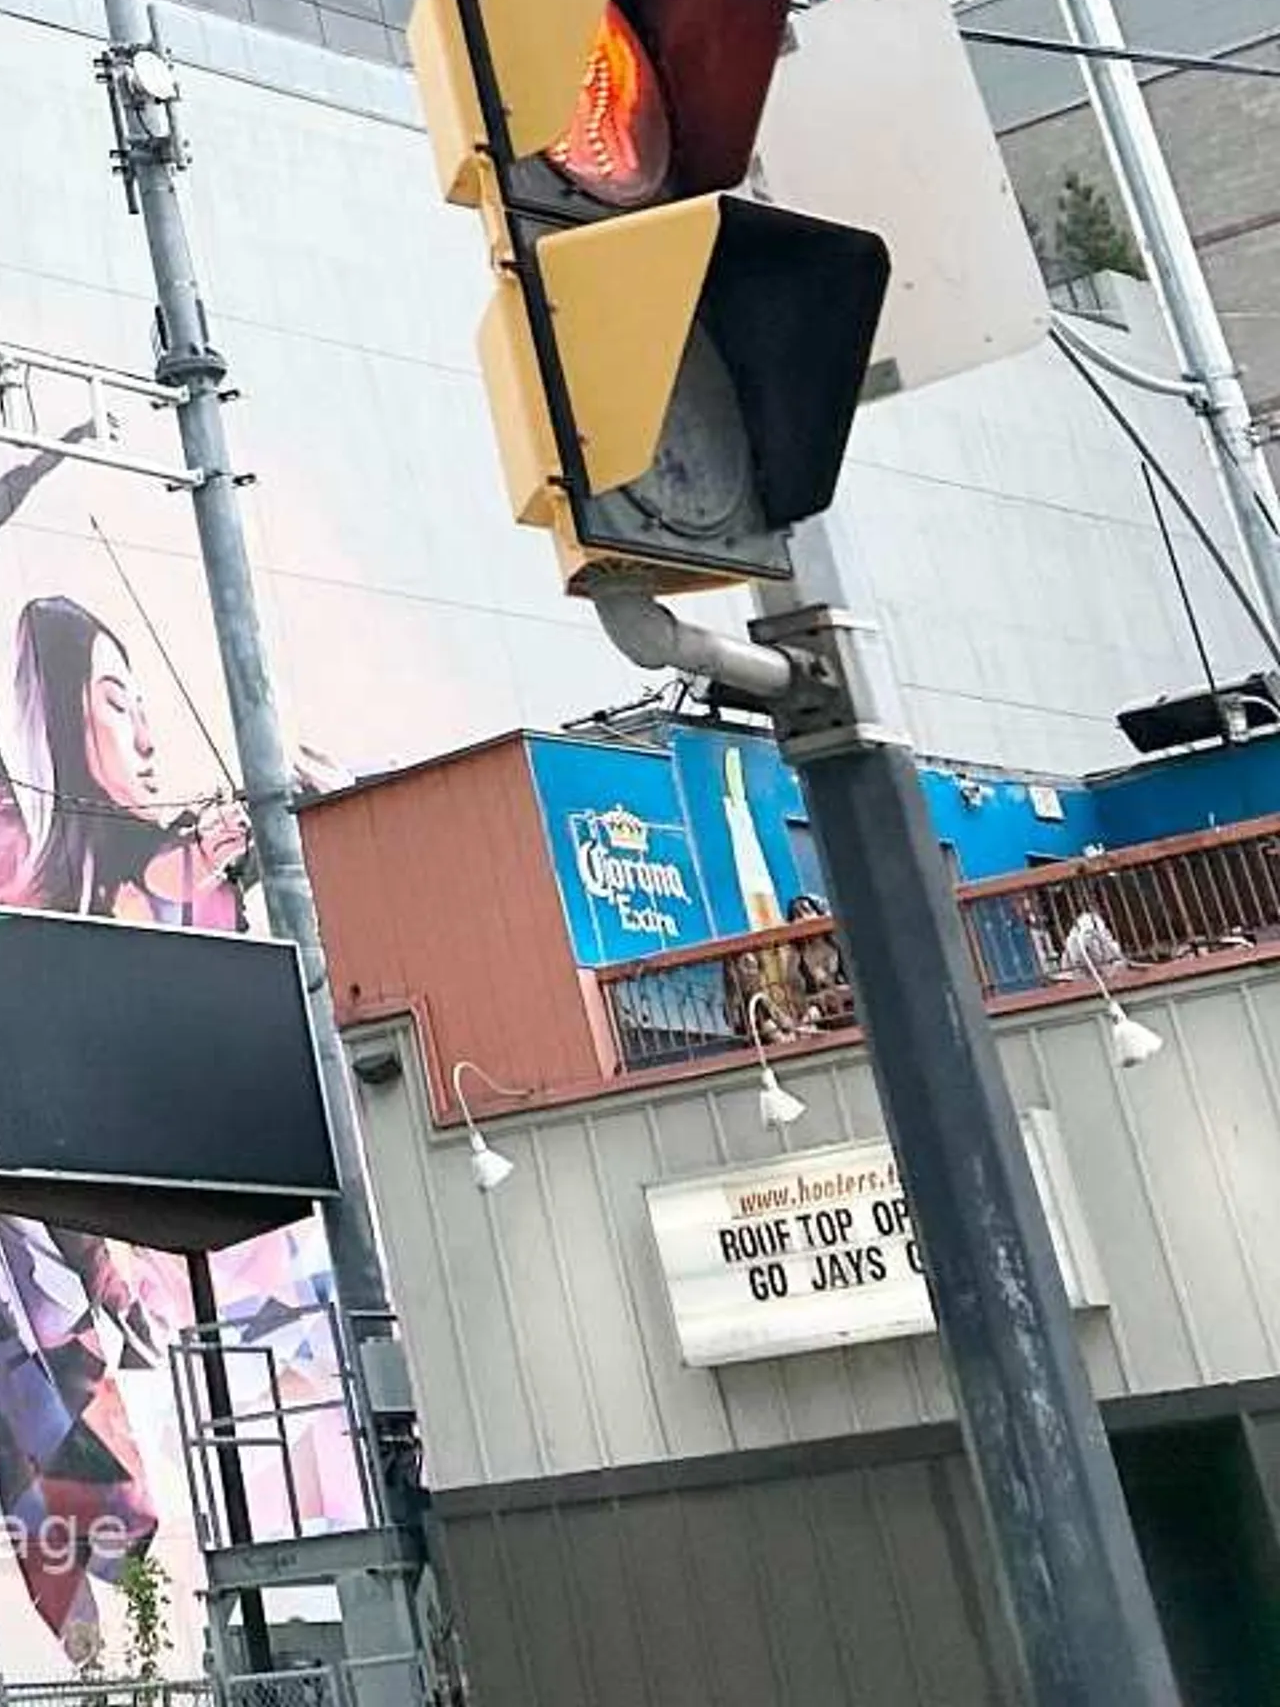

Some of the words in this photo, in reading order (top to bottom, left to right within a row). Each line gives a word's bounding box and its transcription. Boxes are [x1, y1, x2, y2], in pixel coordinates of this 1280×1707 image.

[579, 839, 693, 905] Corona
[616, 892, 681, 938] Extra
[748, 1262, 788, 1302] GO
[810, 1245, 887, 1291] JAYS
